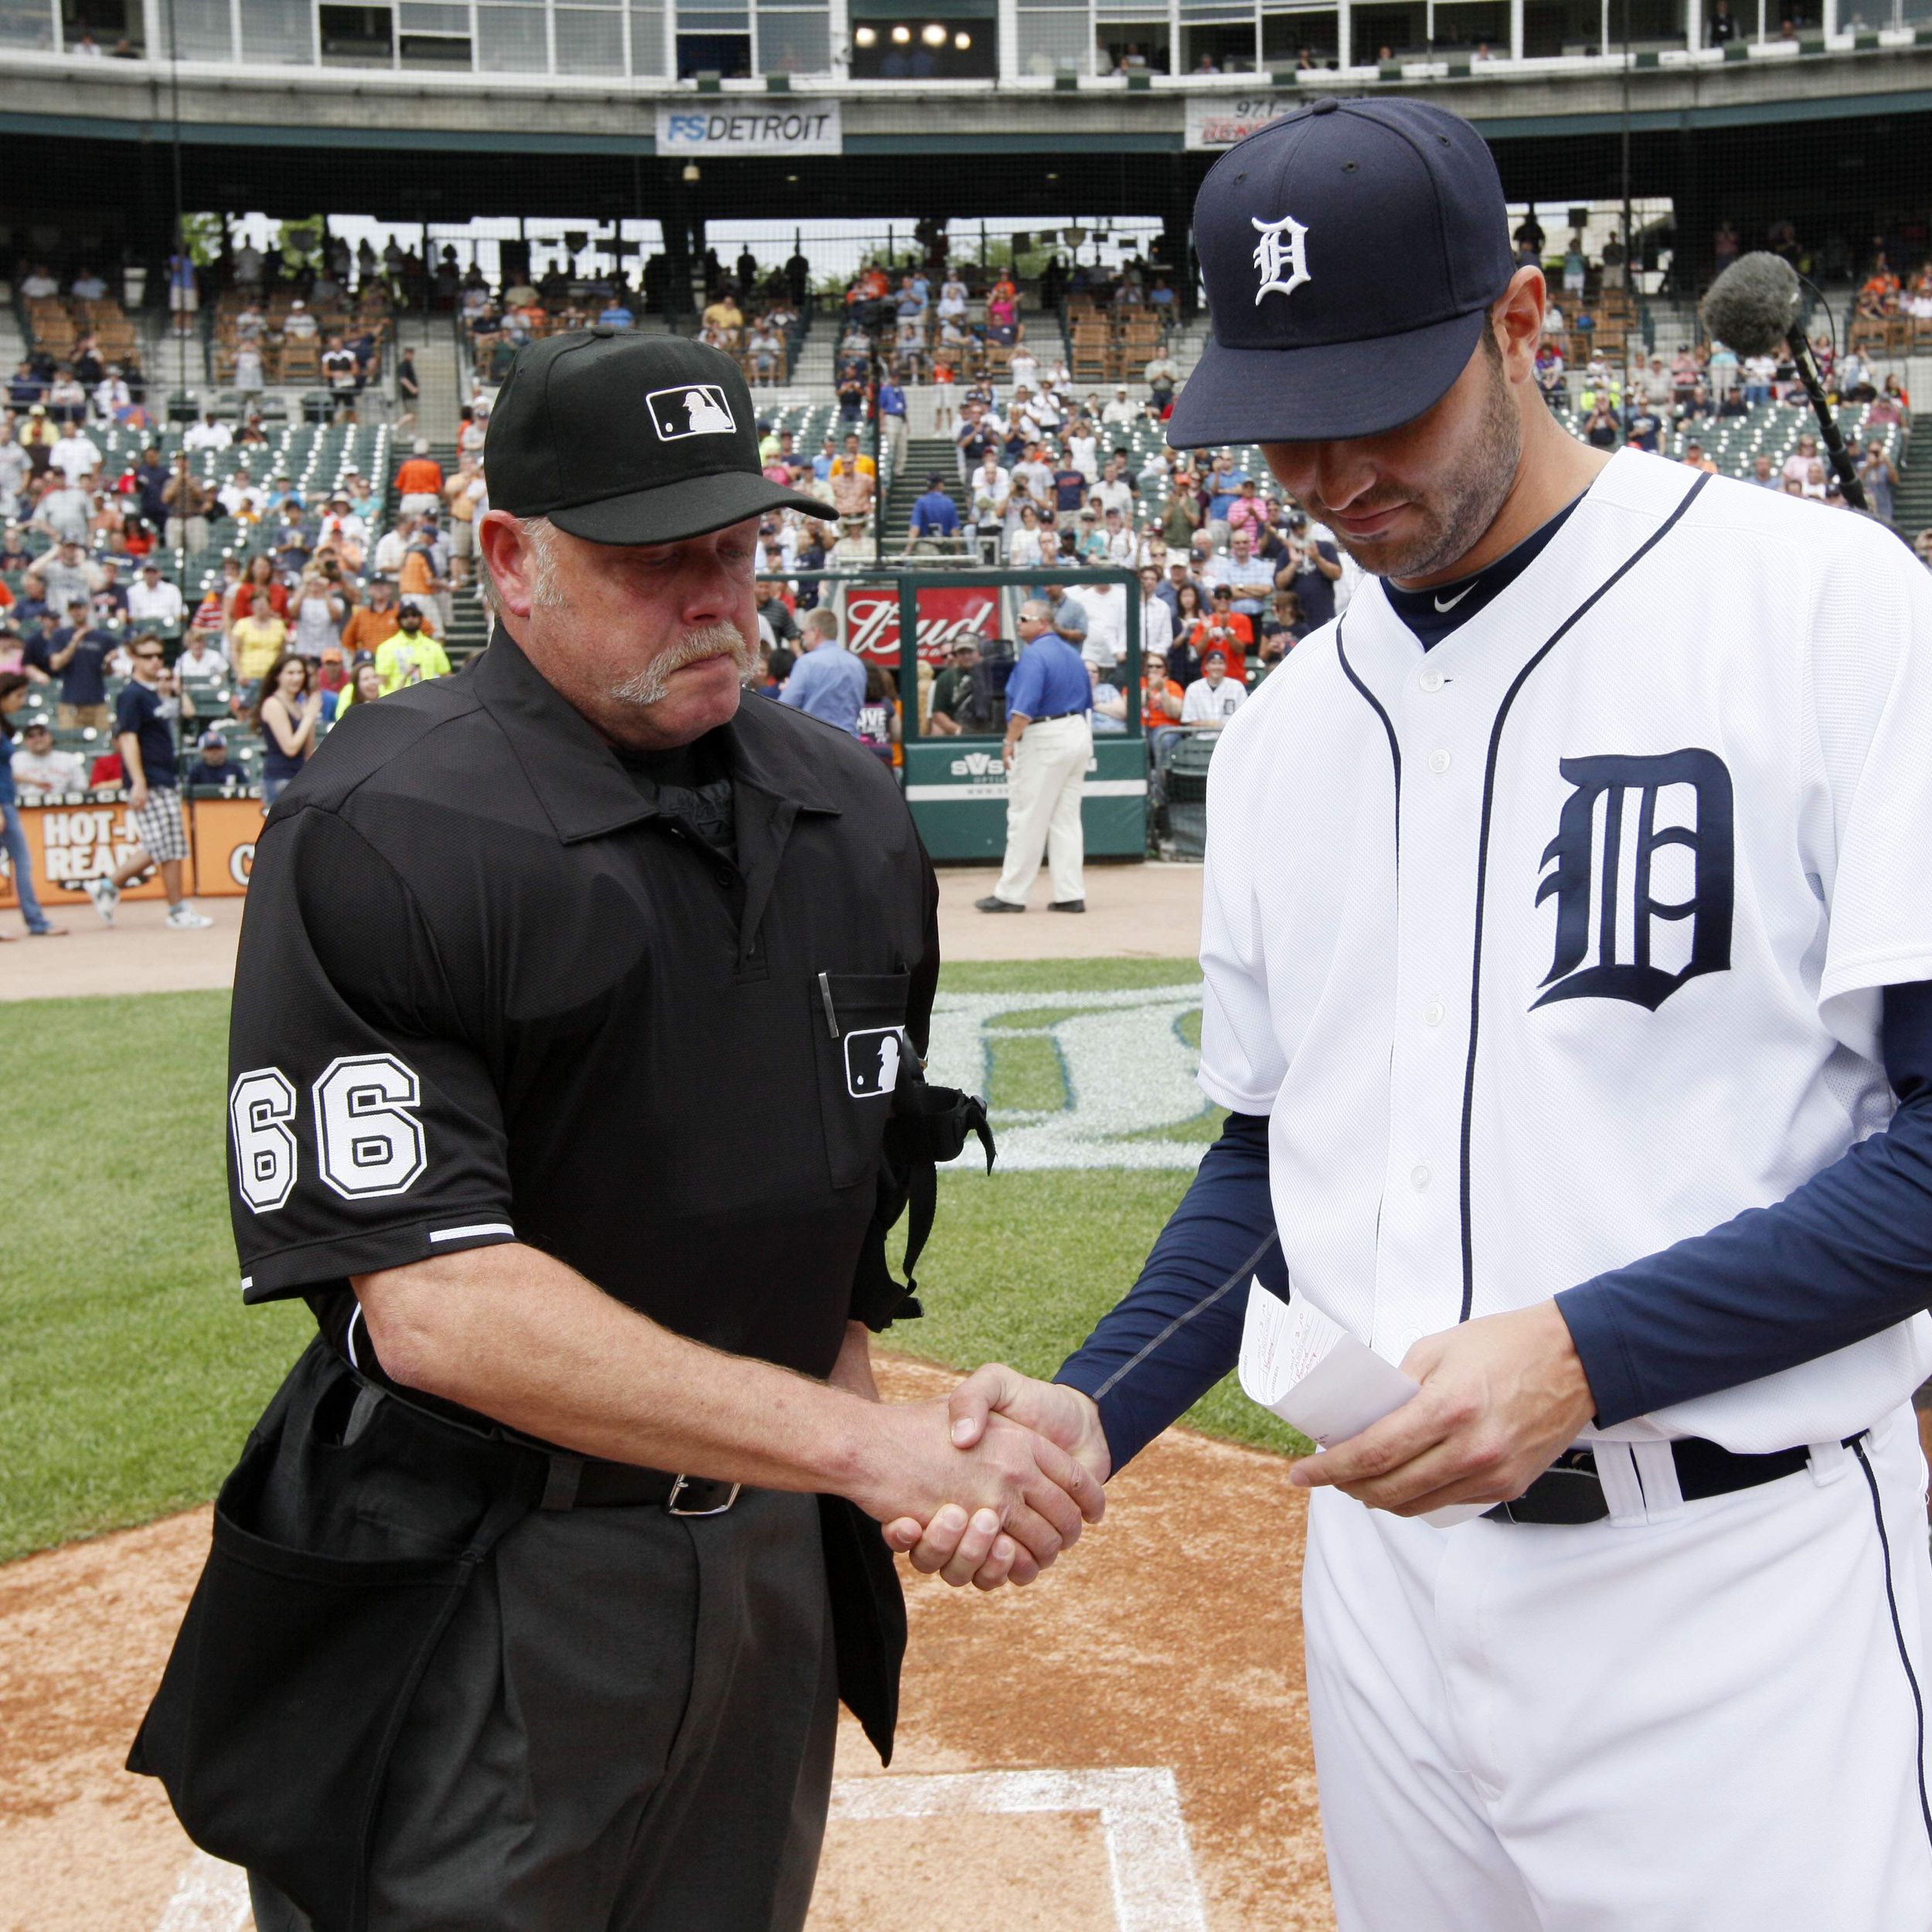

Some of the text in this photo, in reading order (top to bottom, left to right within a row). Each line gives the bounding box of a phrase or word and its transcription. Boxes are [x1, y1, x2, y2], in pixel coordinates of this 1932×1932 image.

[1251, 216, 1311, 306] D
[847, 599, 994, 654] Bud
[1527, 747, 1734, 1013] D
[230, 1053, 427, 1214] 66
